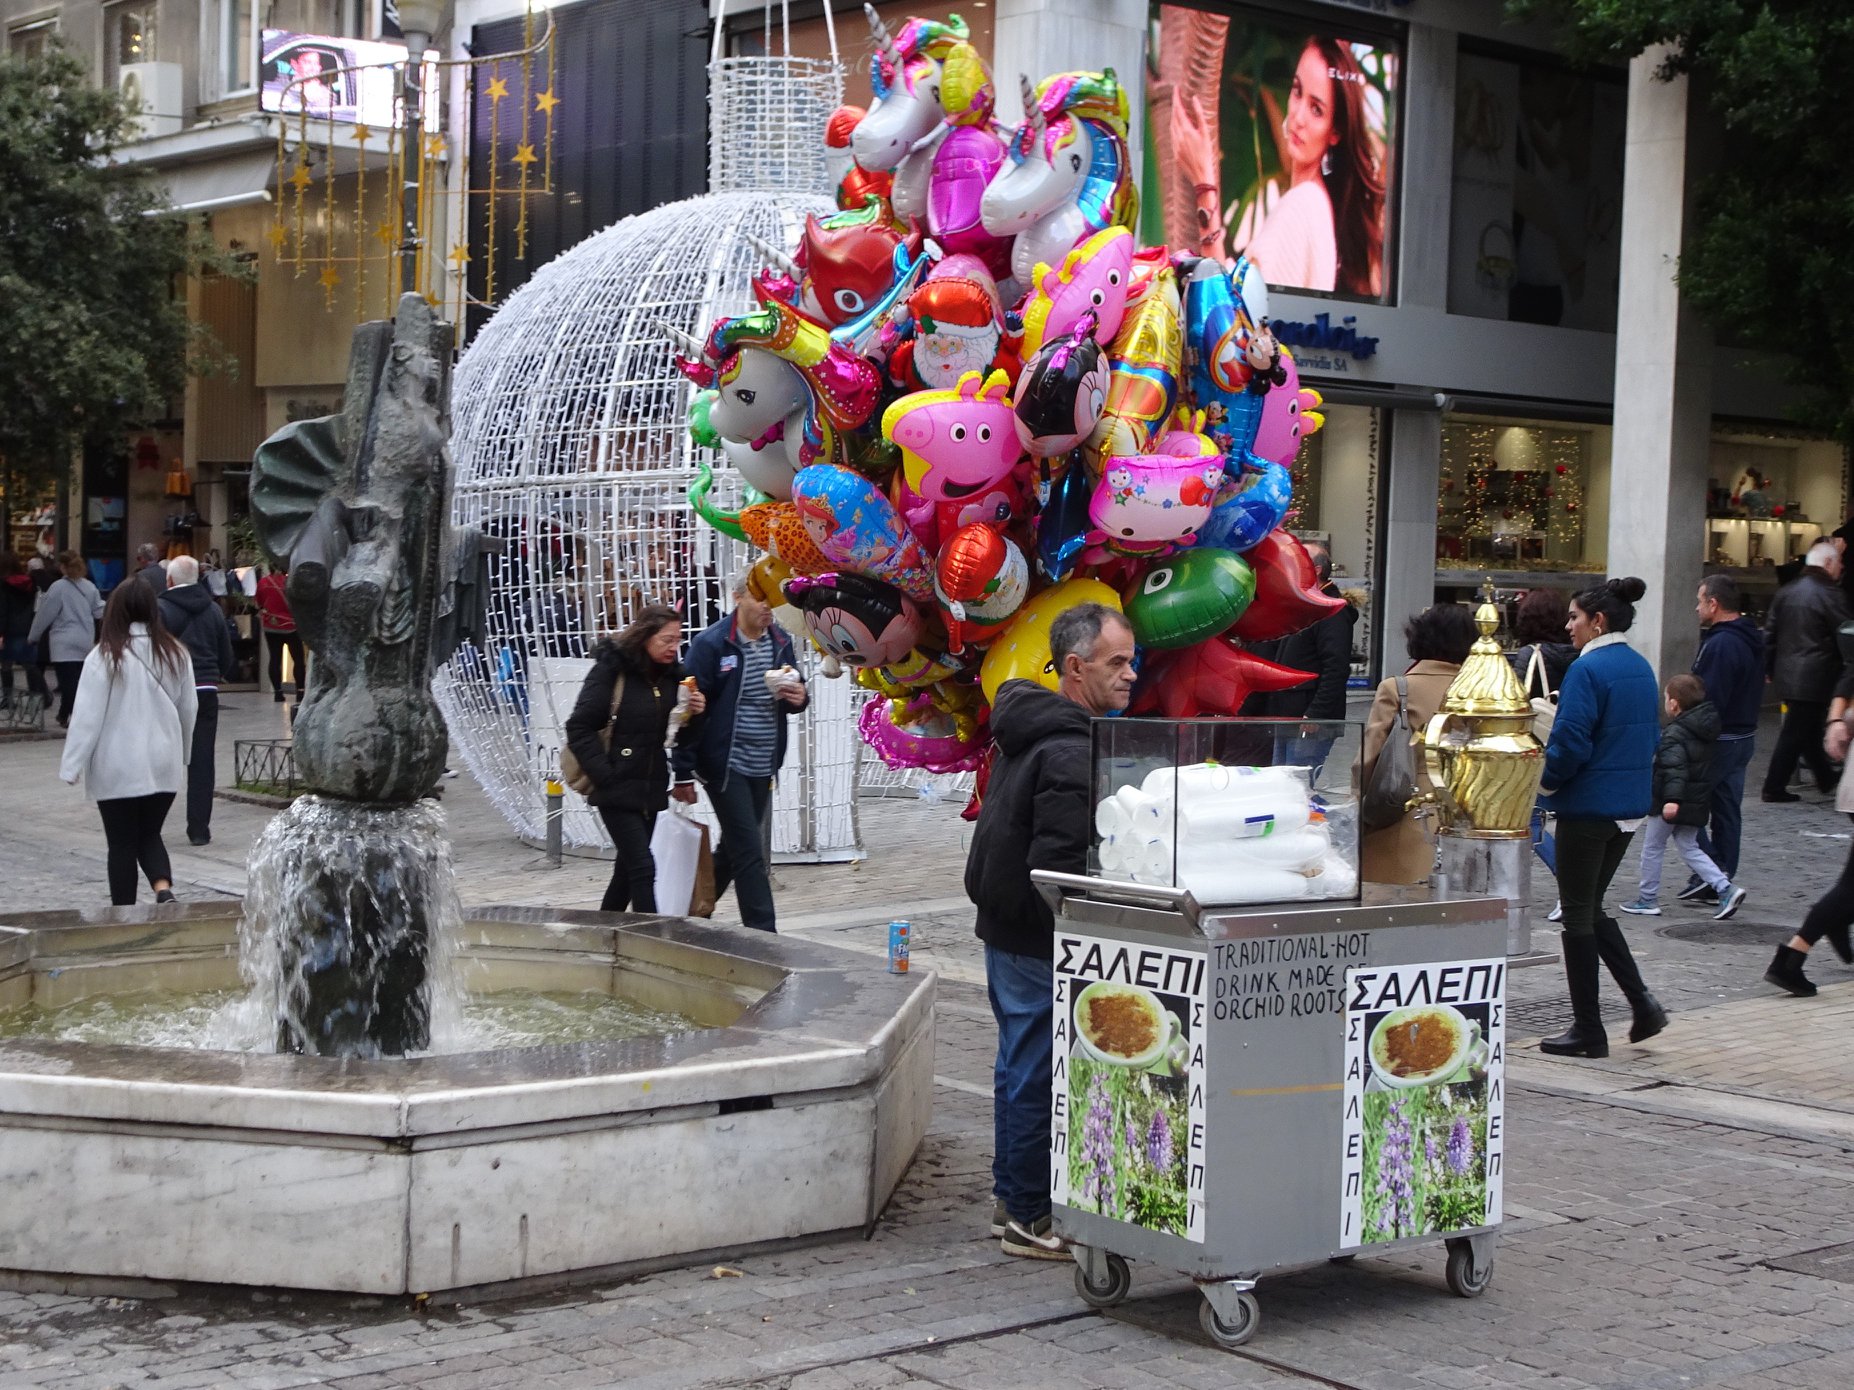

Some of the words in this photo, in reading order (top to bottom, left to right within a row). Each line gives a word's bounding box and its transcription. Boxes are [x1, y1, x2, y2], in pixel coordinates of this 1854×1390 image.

[1056, 938, 1206, 996] ΣΑΛΕΠΙ
[1214, 994, 1285, 1020] ORCHID
[1290, 988, 1347, 1017] ROOTS
[1215, 972, 1280, 998] DRINK
[1288, 965, 1335, 990] MADE
[1349, 964, 1504, 1011] ΣΑΛΕΠΙ
[1052, 979, 1067, 1191] ΣΑΛΕΠΙ
[1189, 1003, 1205, 1228] ΣΑΛΕΠΙ
[1345, 1017, 1361, 1236] ΣΑΛΕΠΙ
[1487, 1004, 1503, 1214] ΣΑΛΕΠΙ
